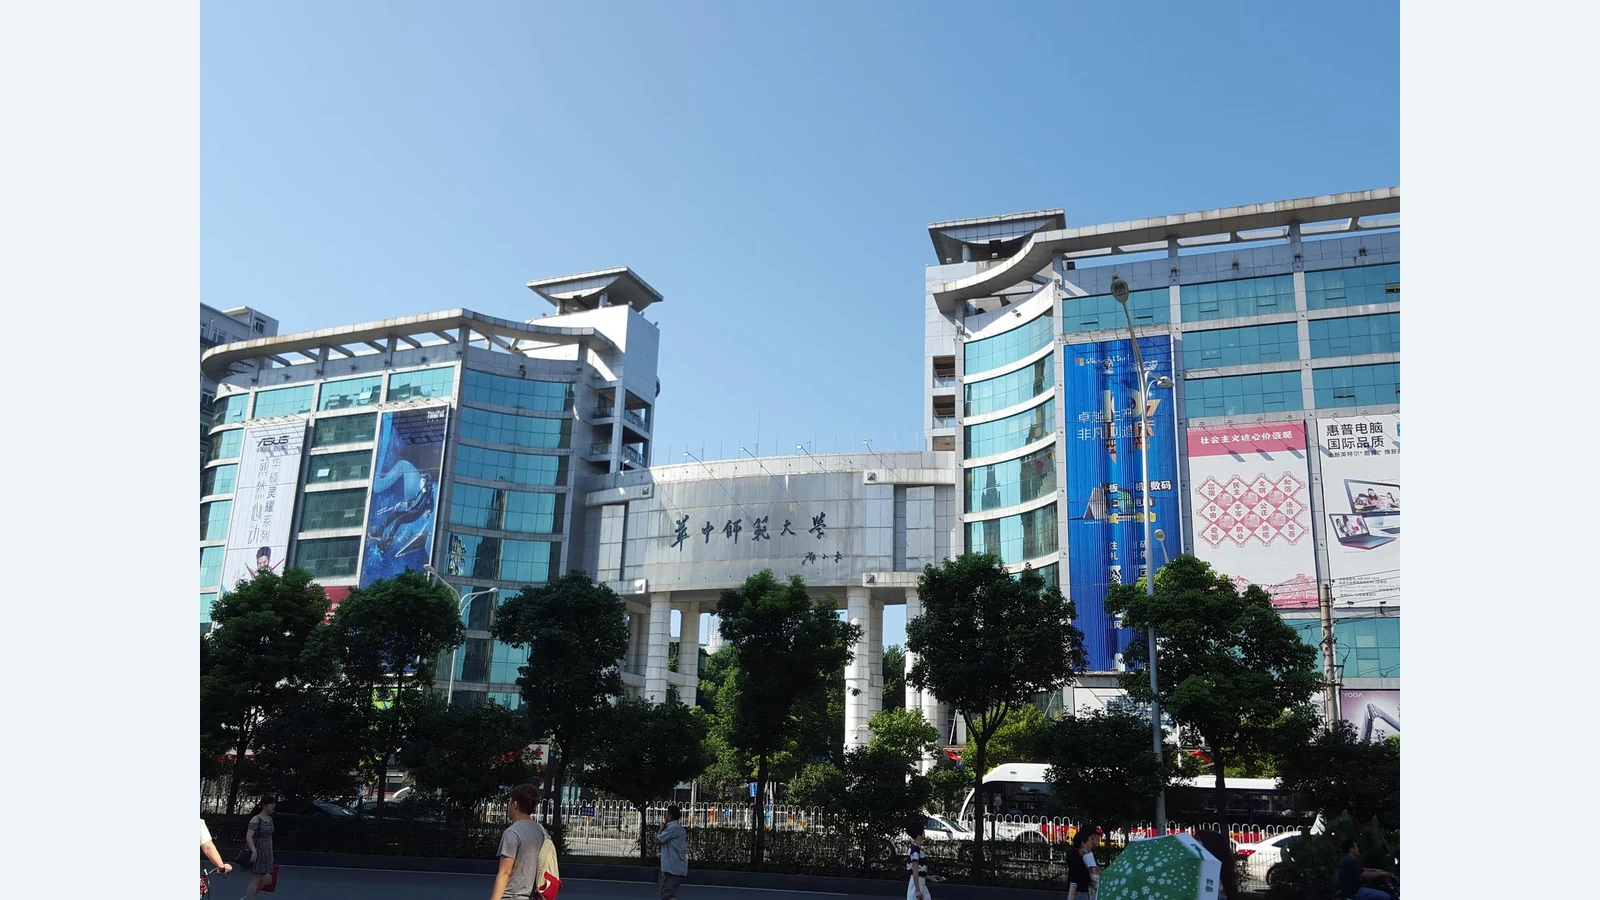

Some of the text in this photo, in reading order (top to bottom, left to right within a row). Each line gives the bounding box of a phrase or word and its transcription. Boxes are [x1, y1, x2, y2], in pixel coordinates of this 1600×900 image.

[1326, 422, 1383, 436] 惠普电脑
[257, 435, 289, 447] ASUS
[1200, 430, 1293, 445] 社会主义核心价值观
[1327, 435, 1384, 450] 国际品质
[1150, 480, 1172, 491] 数码
[260, 456, 281, 543] 华硕灵耀系列
